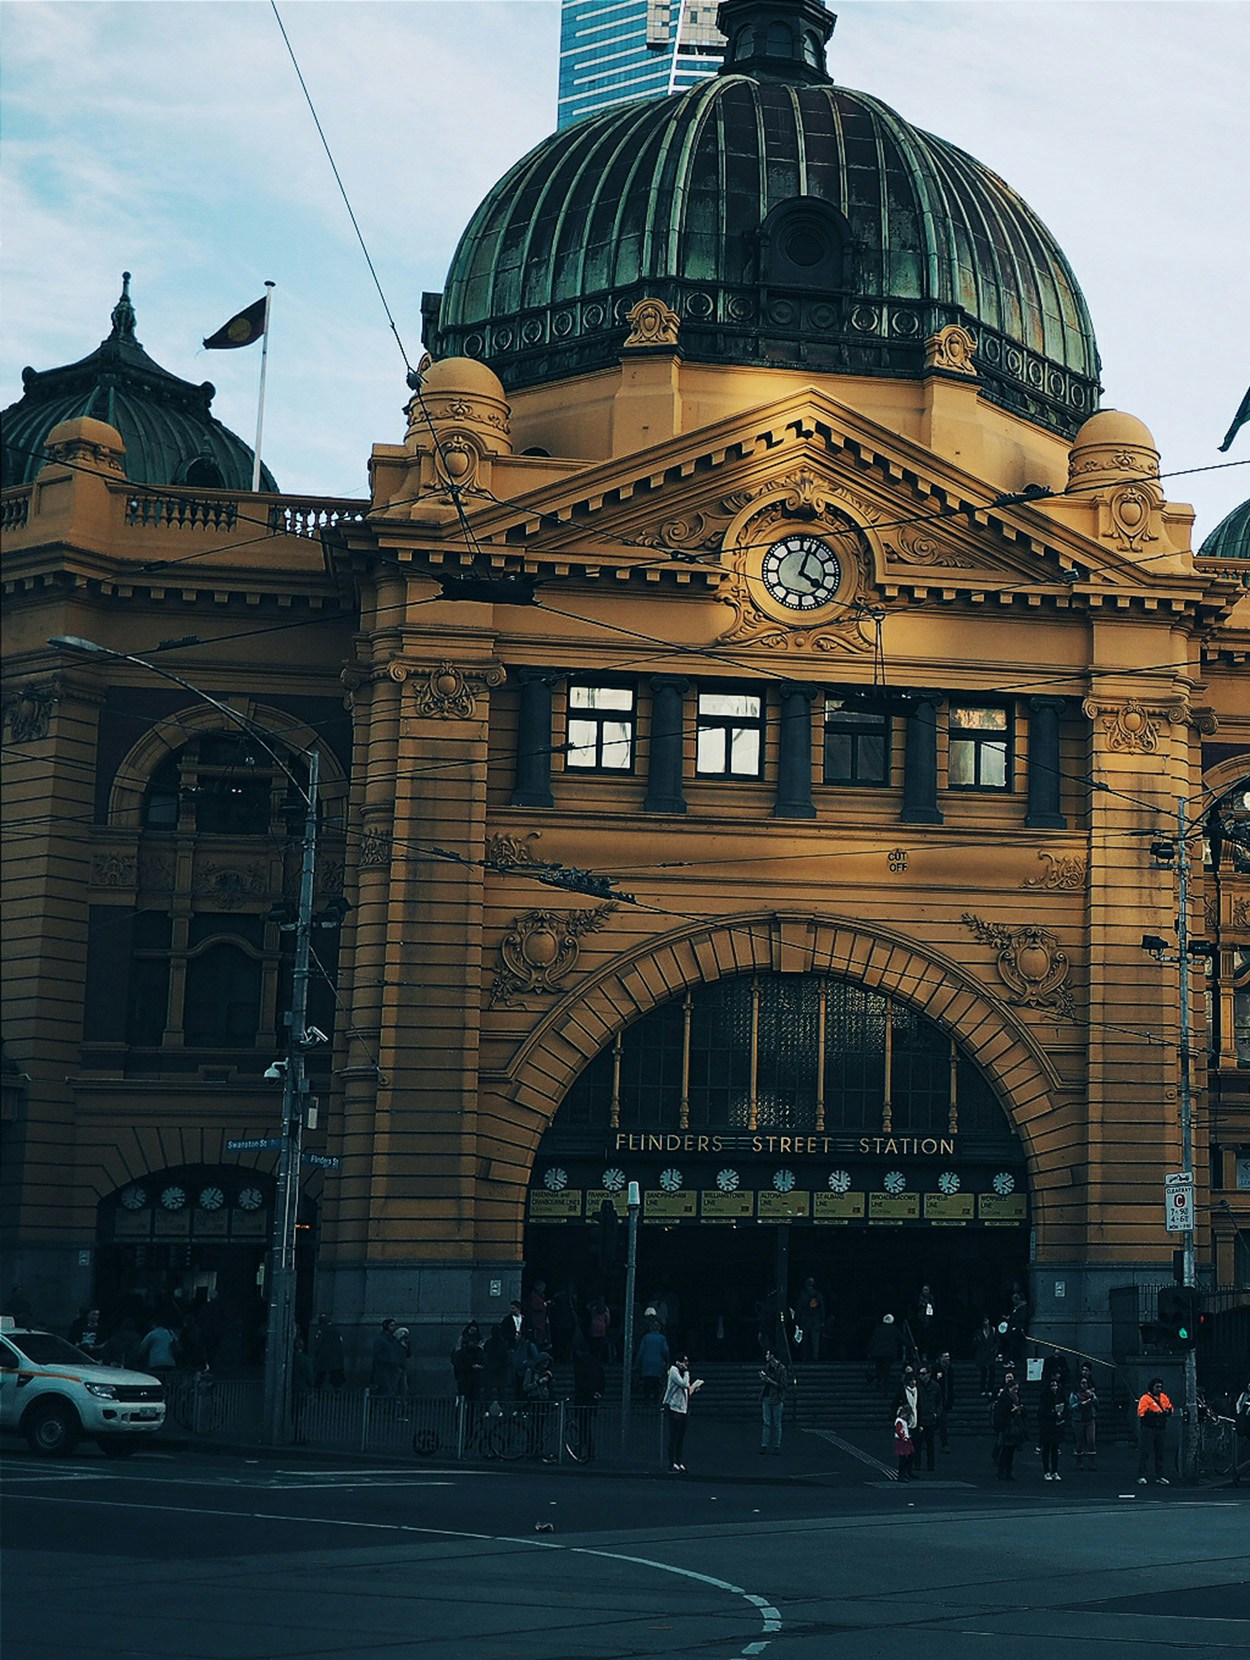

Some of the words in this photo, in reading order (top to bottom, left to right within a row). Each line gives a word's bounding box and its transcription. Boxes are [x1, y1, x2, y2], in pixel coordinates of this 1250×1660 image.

[888, 851, 907, 861] CUT
[890, 863, 908, 872] OFF
[228, 1140, 259, 1150] Swanston
[260, 1139, 267, 1148] St
[616, 1133, 723, 1152] FLINDERS
[752, 1135, 832, 1153] STREET
[859, 1137, 953, 1154] STATION
[310, 1155, 332, 1165] Flinders
